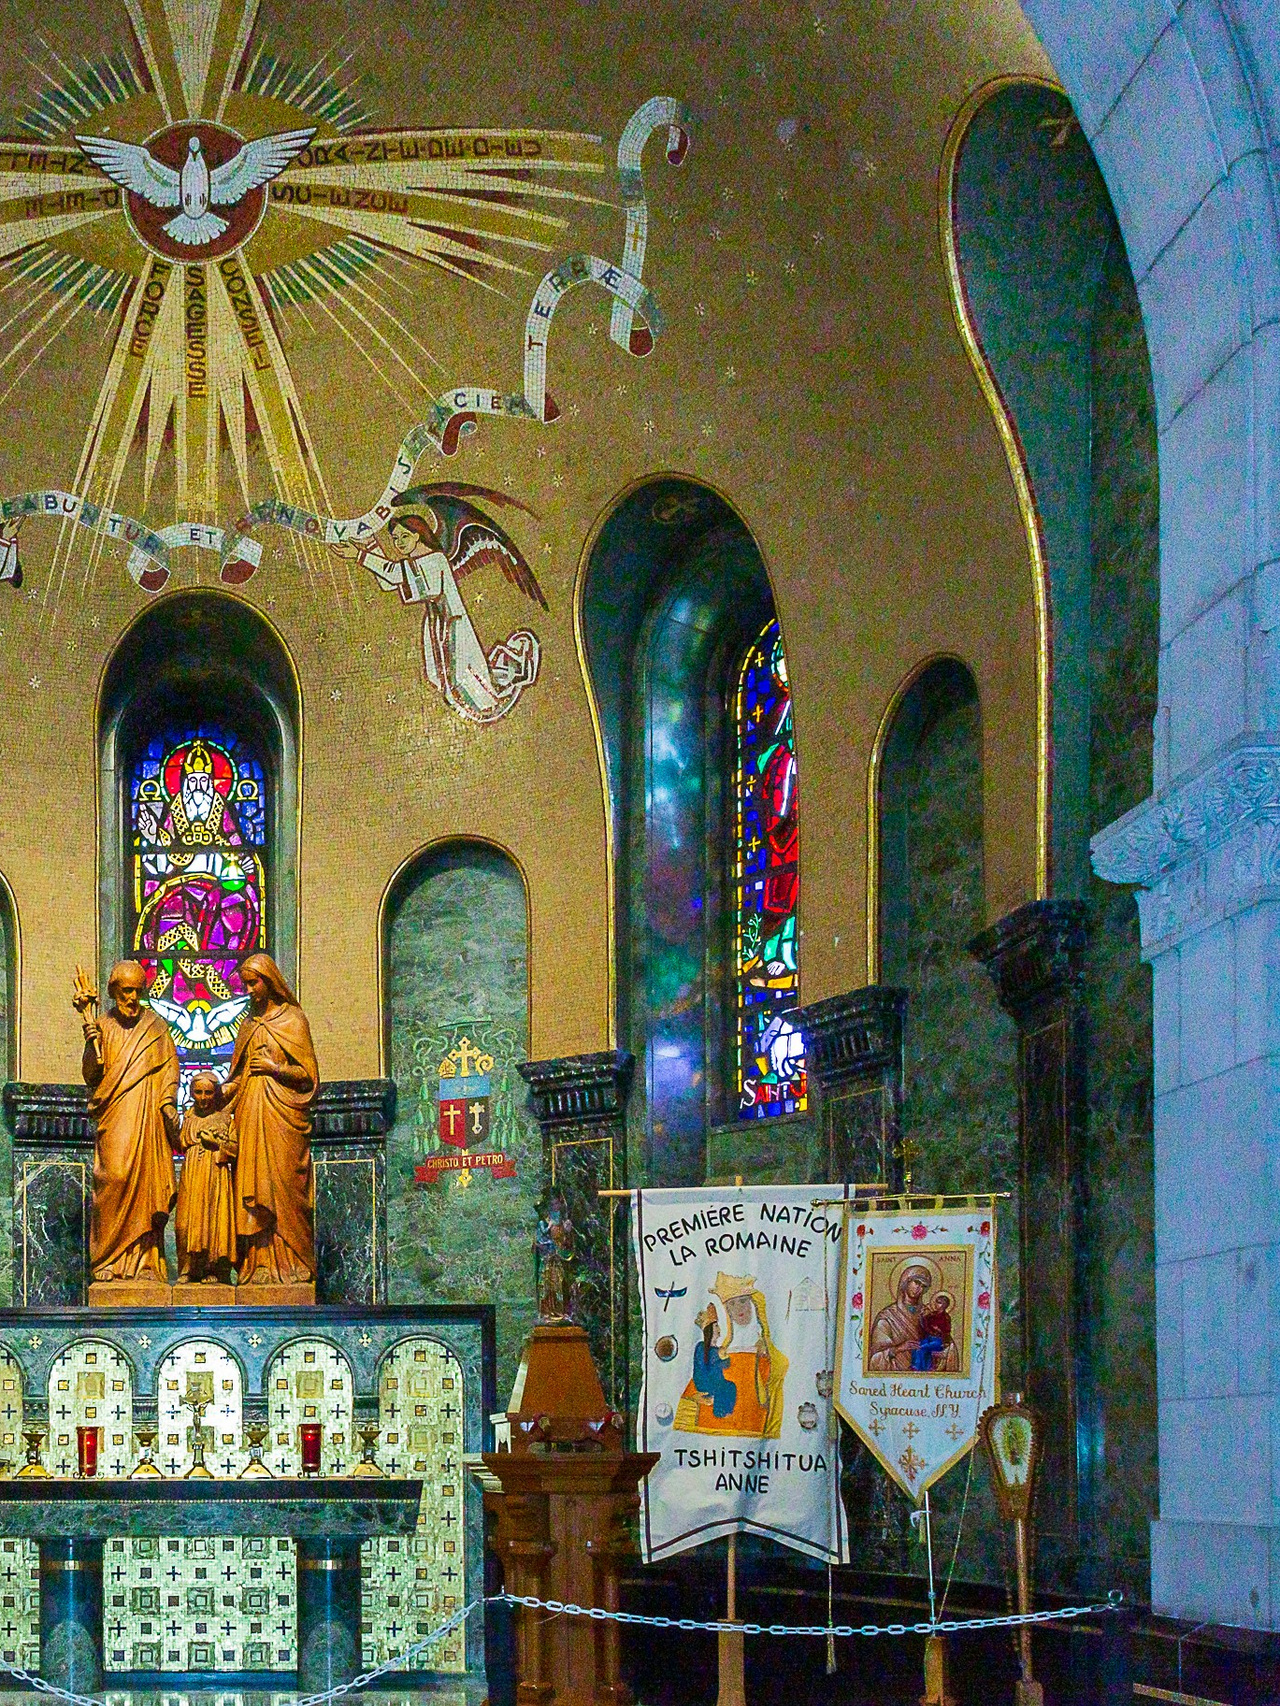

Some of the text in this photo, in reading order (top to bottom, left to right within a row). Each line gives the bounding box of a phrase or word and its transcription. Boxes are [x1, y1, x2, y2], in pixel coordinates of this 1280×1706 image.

[130, 261, 170, 358] FORCE
[220, 257, 271, 371] CONSEIL
[185, 265, 207, 399] SAGESSE
[190, 528, 218, 545] ET
[427, 1154, 504, 1169] CHRISTO ET PETRO
[669, 1233, 812, 1267] LA ROMAINE
[890, 1382, 931, 1398] Heart
[715, 1472, 770, 1494] ANNE
